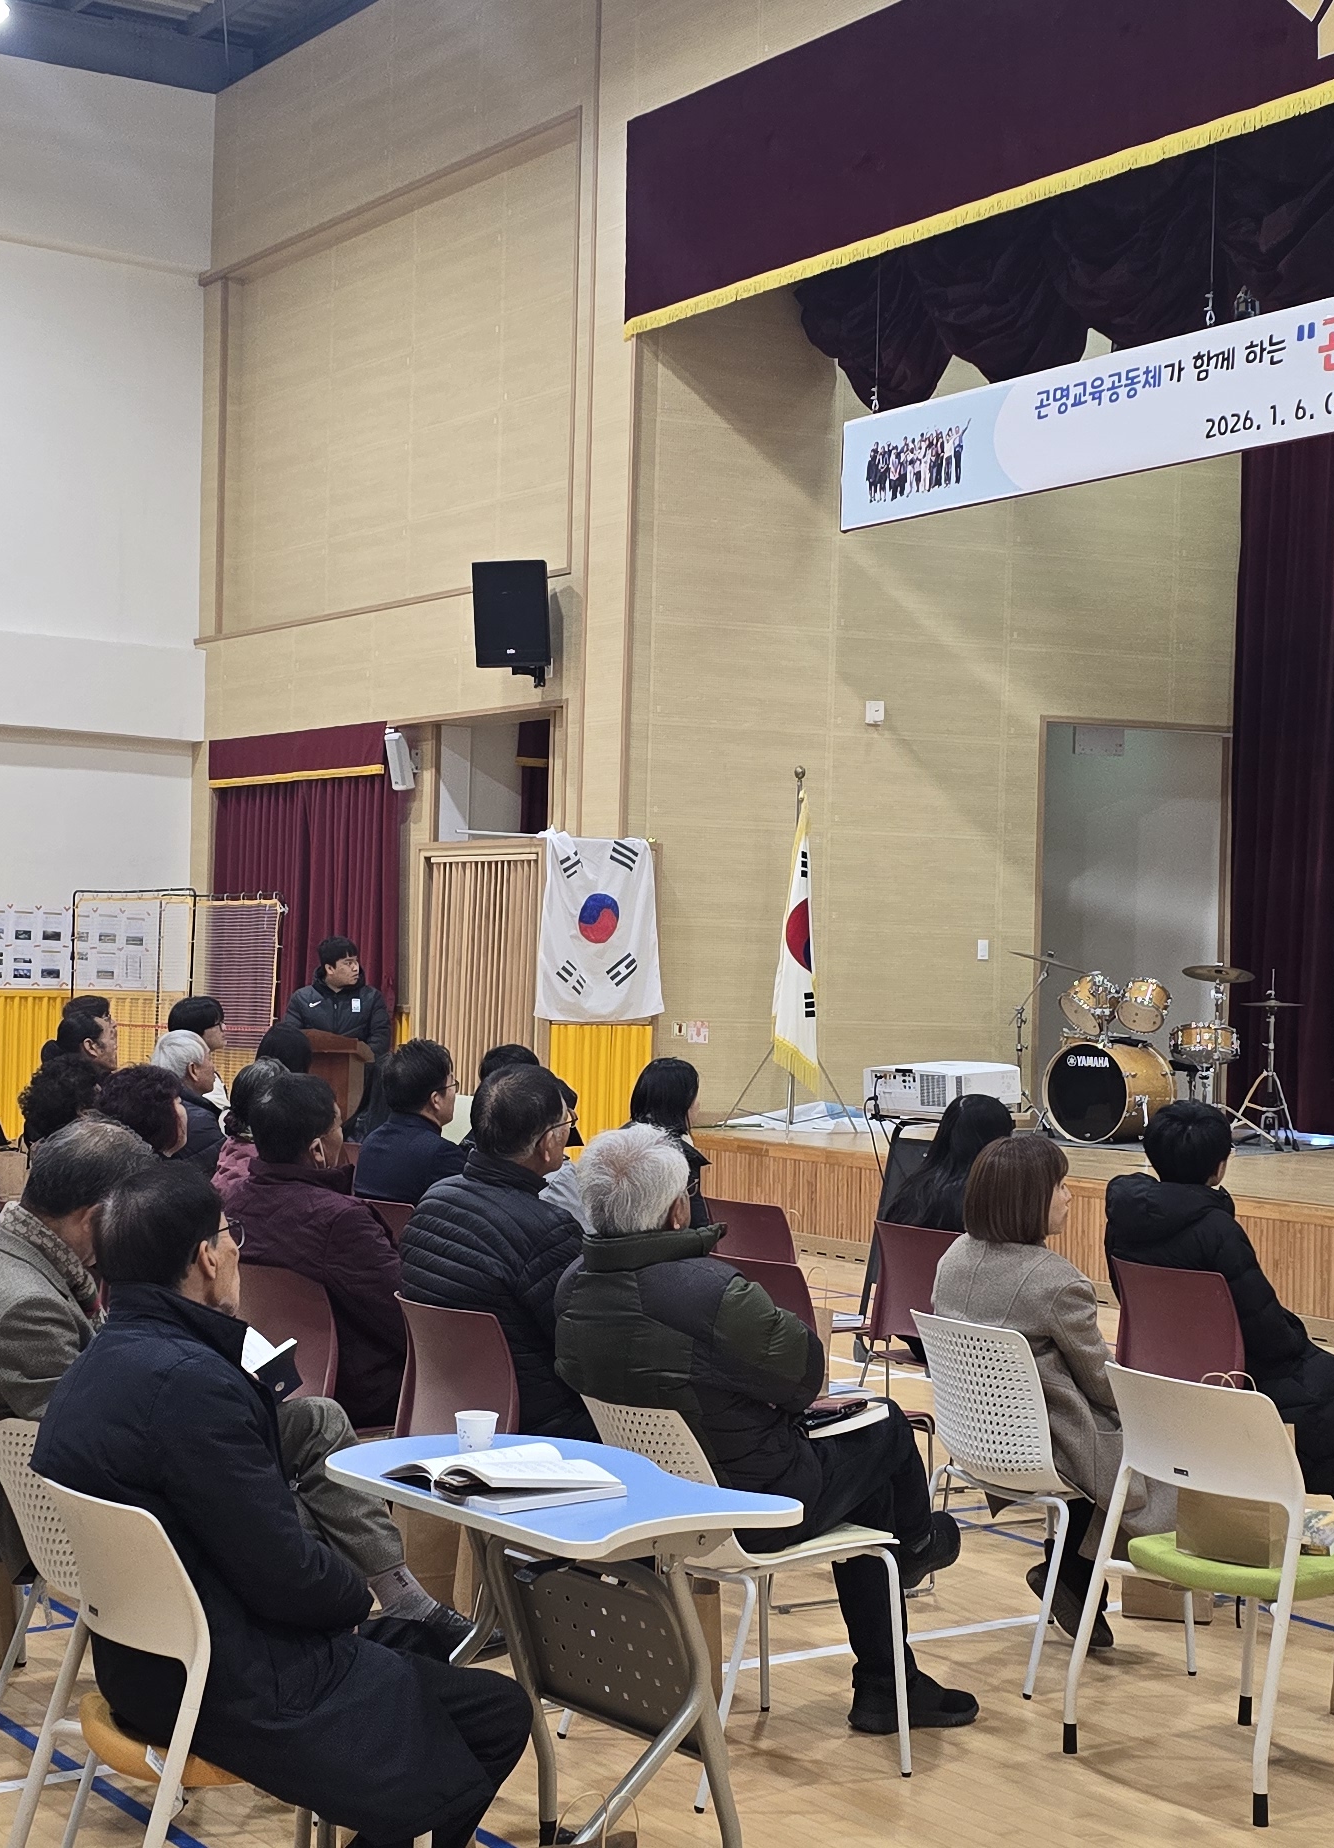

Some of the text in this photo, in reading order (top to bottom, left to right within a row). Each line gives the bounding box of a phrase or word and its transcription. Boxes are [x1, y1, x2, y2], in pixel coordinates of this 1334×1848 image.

[1034, 363, 1185, 421] 곤명교육공동체가
[1193, 348, 1235, 382] 함께
[1245, 333, 1287, 366] 하는
[1204, 413, 1262, 440] 2026.
[1270, 403, 1286, 427] 1.
[1294, 397, 1315, 421] 6.
[1077, 1055, 1109, 1068] YAMAHA
